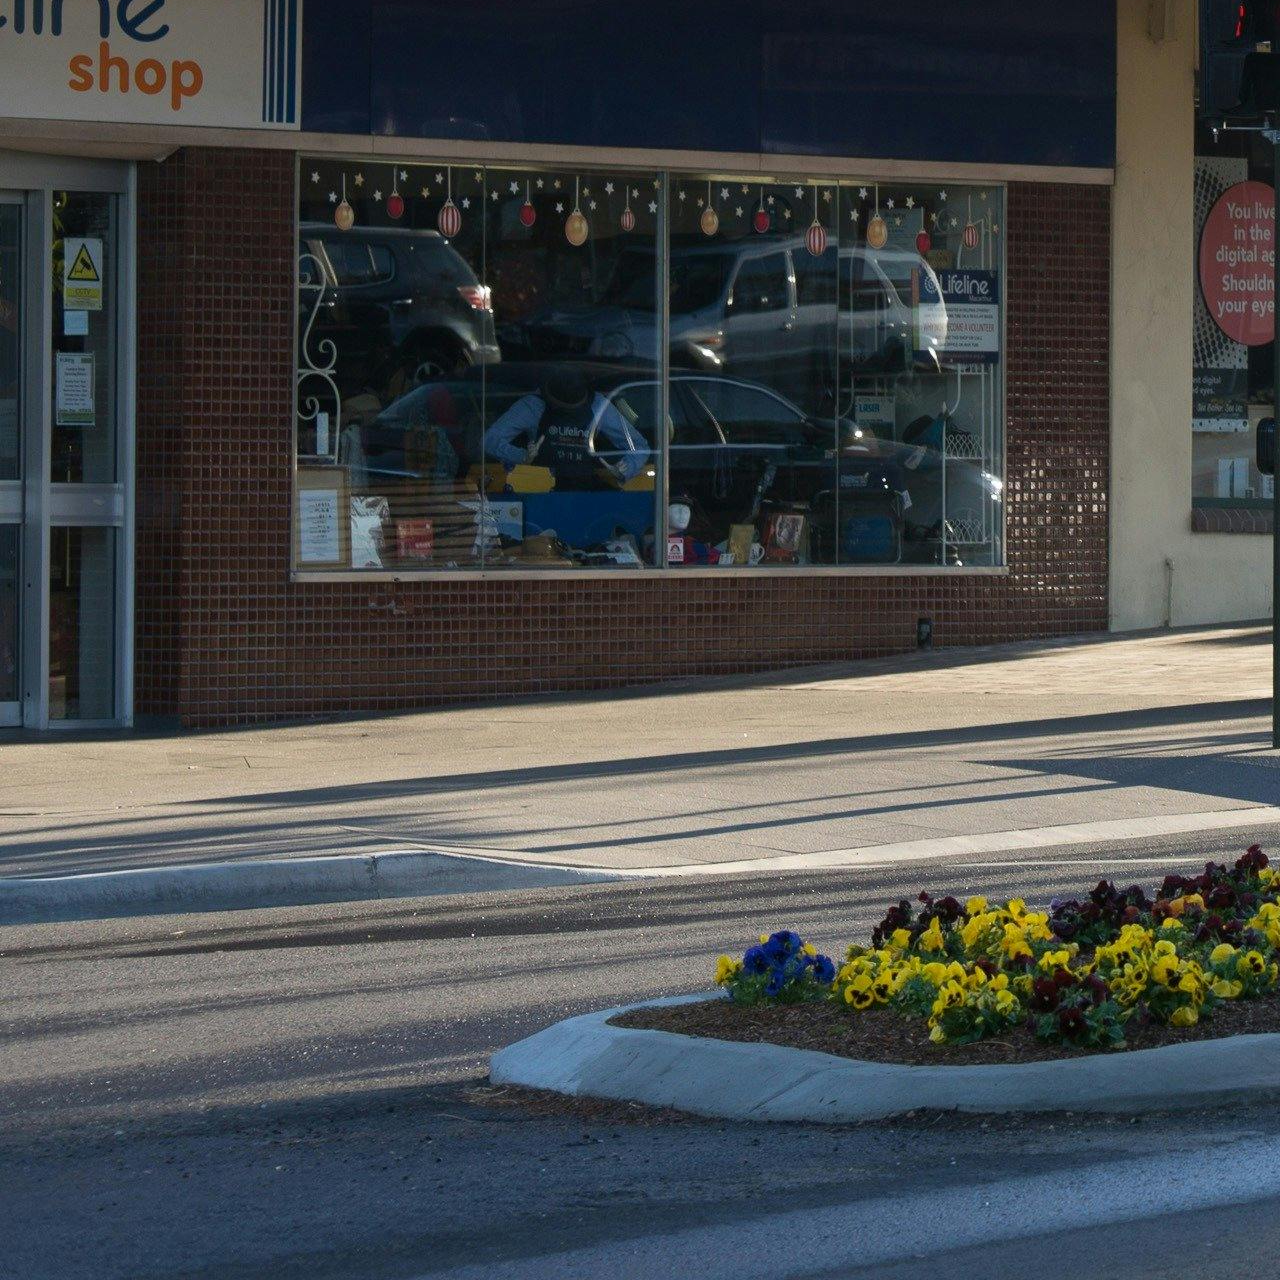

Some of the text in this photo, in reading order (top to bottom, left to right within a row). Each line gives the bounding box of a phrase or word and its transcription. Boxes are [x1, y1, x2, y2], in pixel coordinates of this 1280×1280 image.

[69, 41, 204, 111] shop
[1226, 202, 1251, 219] You
[1234, 223, 1271, 240] in the
[1216, 246, 1275, 268] digital ag
[940, 274, 989, 295] Lifeline
[1222, 274, 1275, 292] Shouldn
[1217, 302, 1275, 319] your eye
